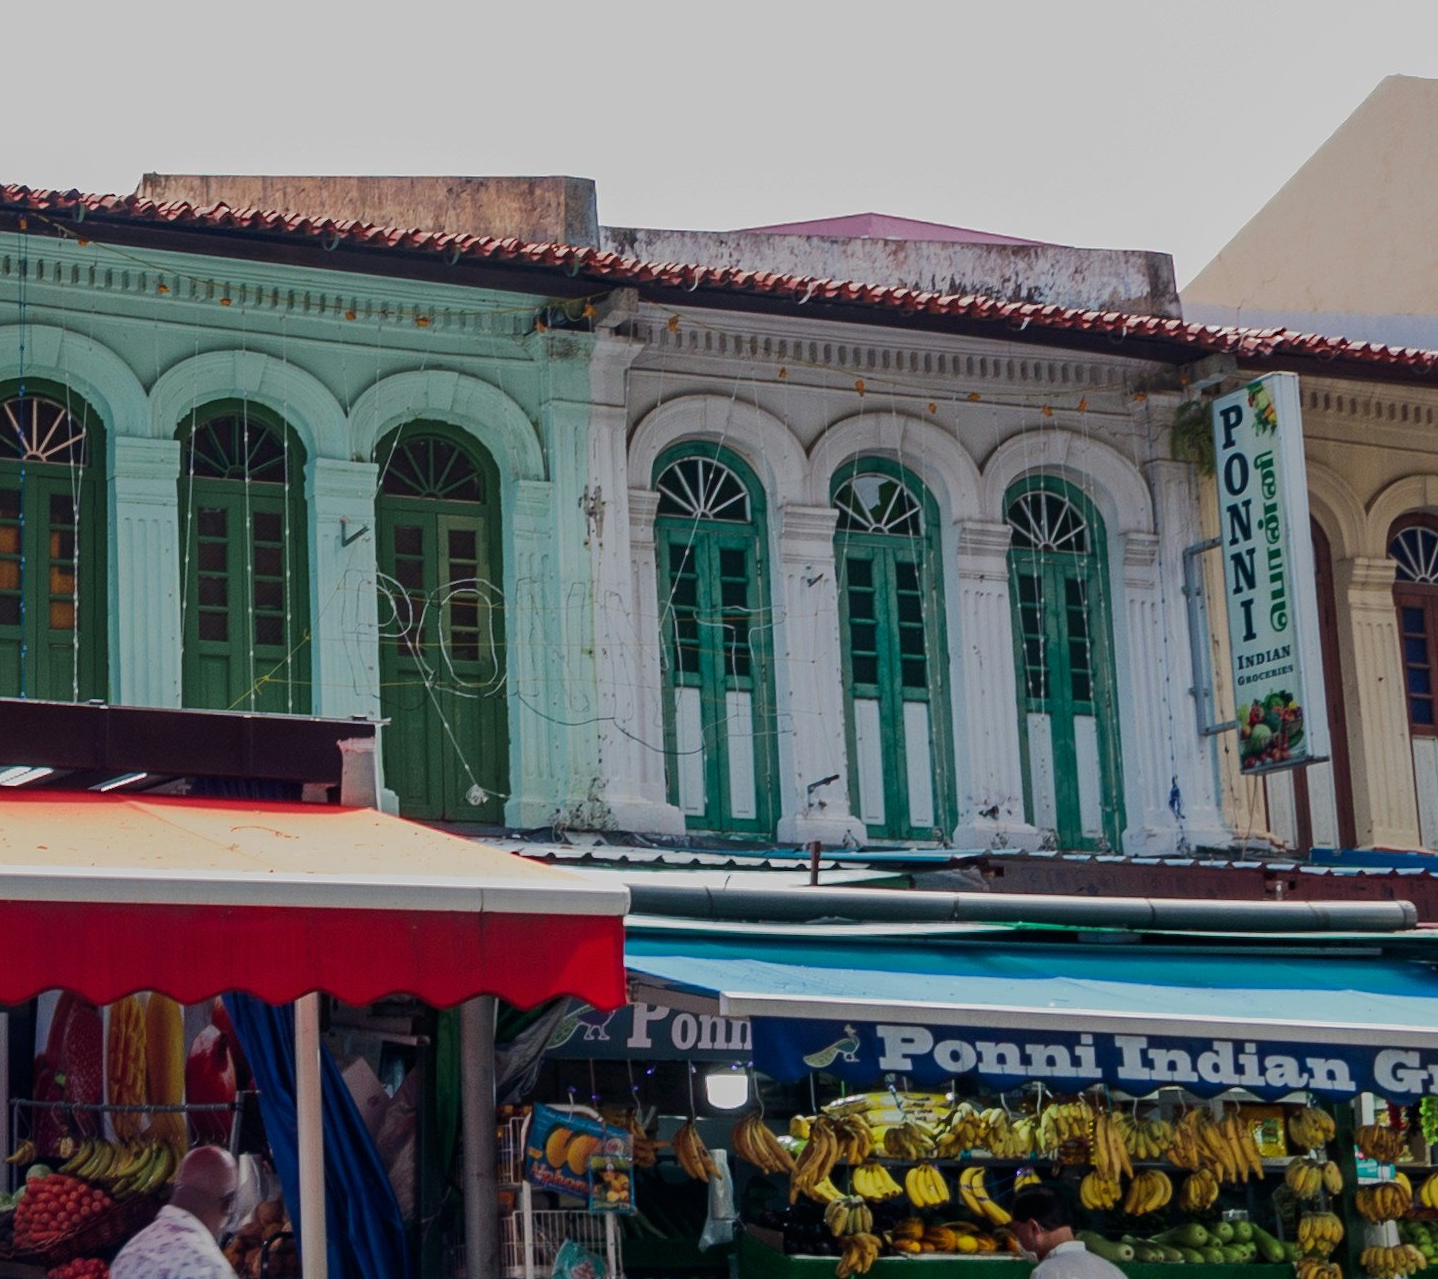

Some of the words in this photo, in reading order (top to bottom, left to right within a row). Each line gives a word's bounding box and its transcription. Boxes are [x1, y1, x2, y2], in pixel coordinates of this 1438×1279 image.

[1219, 404, 1257, 642] PONNI
[1236, 644, 1291, 671] INDIAN
[1237, 664, 1294, 686] GROCERIES
[876, 1024, 1103, 1079] Ponni
[1114, 1034, 1357, 1092] Indian
